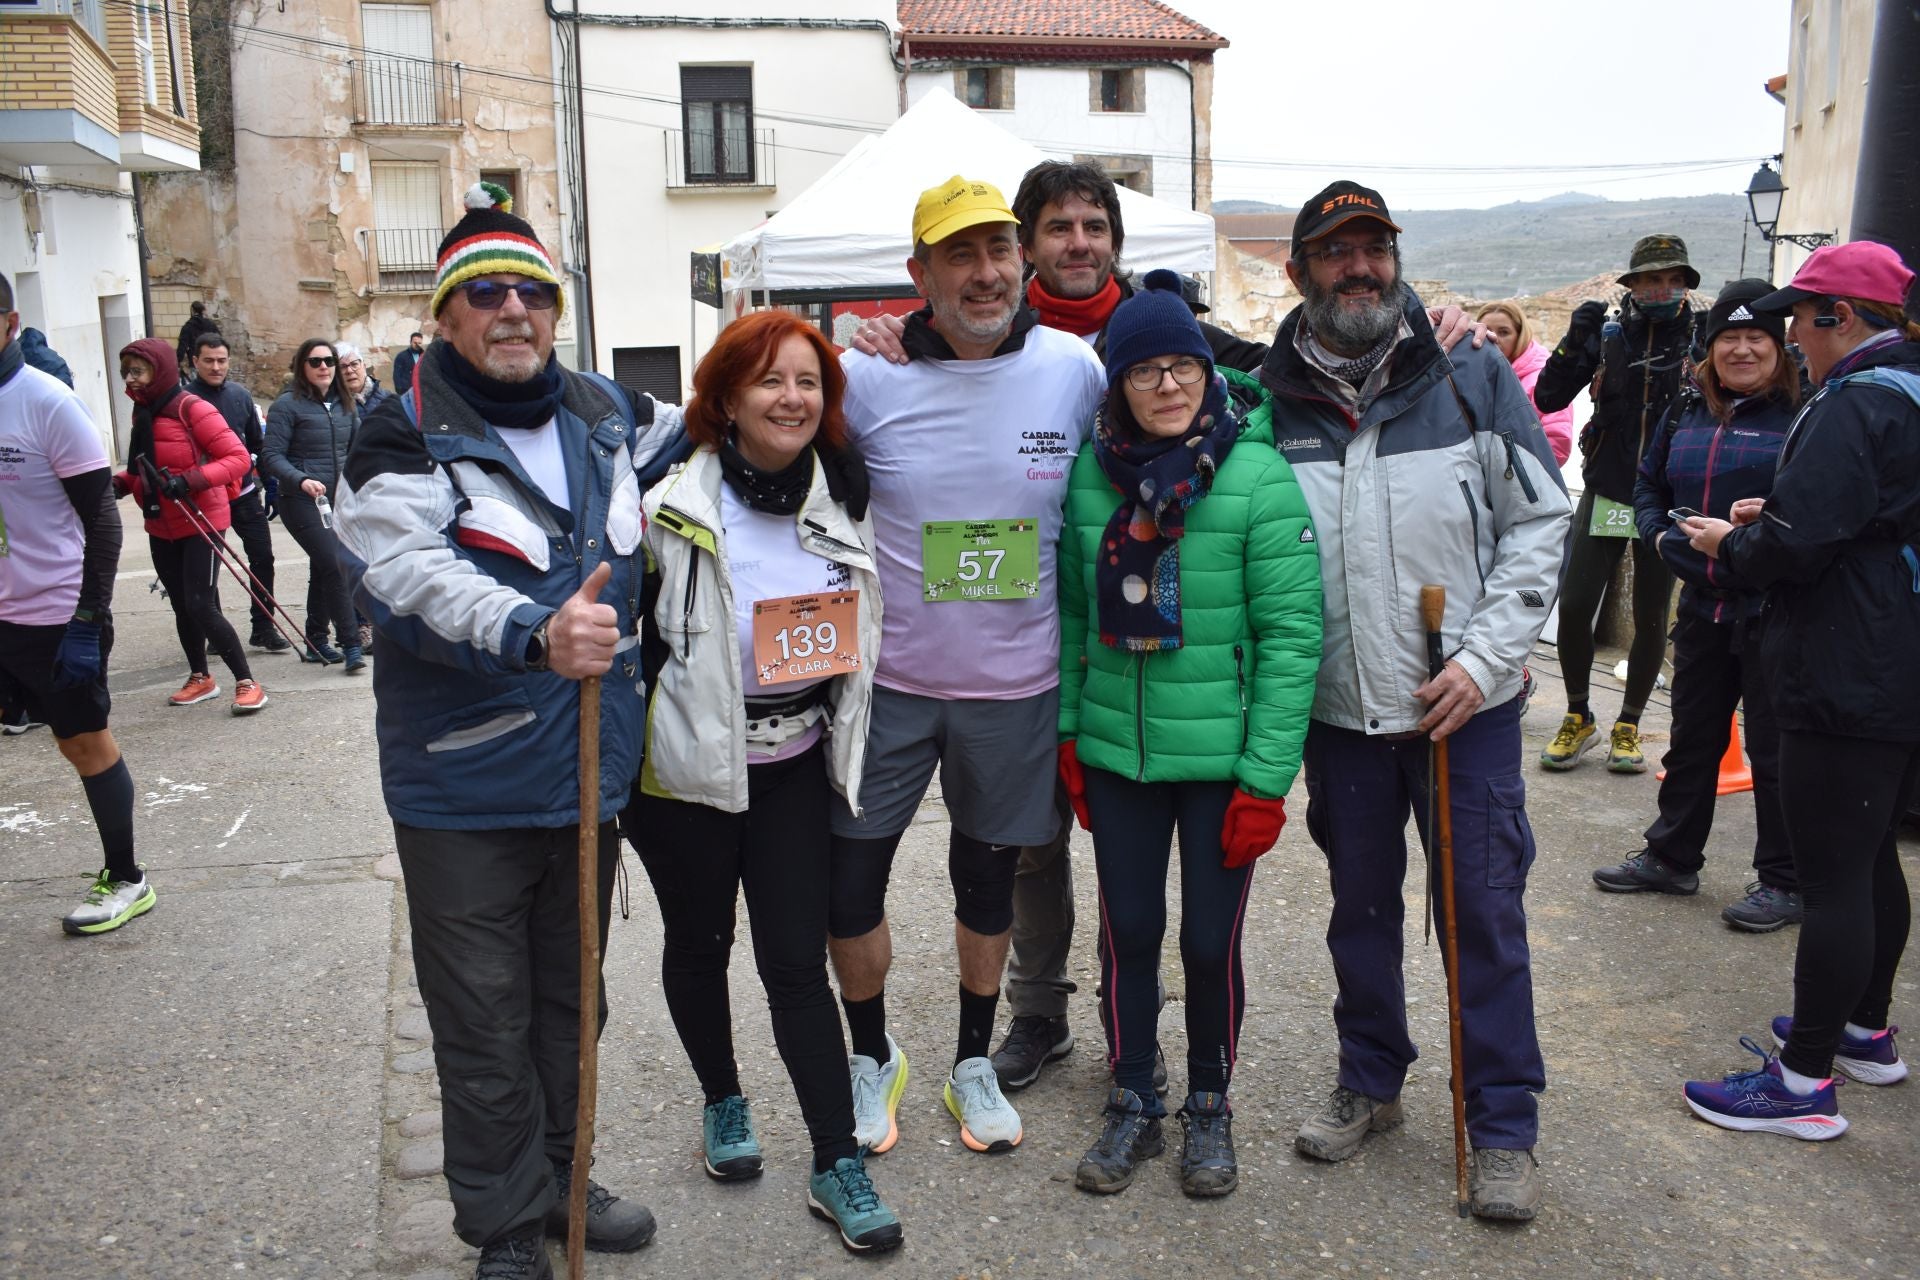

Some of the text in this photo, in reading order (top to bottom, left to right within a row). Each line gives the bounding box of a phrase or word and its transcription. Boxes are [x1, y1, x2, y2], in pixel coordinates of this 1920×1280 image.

[1321, 193, 1379, 215] STIHL
[1021, 431, 1067, 441] CARRERA
[1283, 437, 1321, 446] Columbia
[1017, 445, 1069, 455] ALMENDROS
[1605, 508, 1631, 526] 25
[1607, 527, 1626, 536] JUAN
[956, 548, 1006, 582] 57
[961, 584, 1003, 597] MIKEL
[774, 621, 838, 661] 139
[788, 659, 832, 676] CLARA
